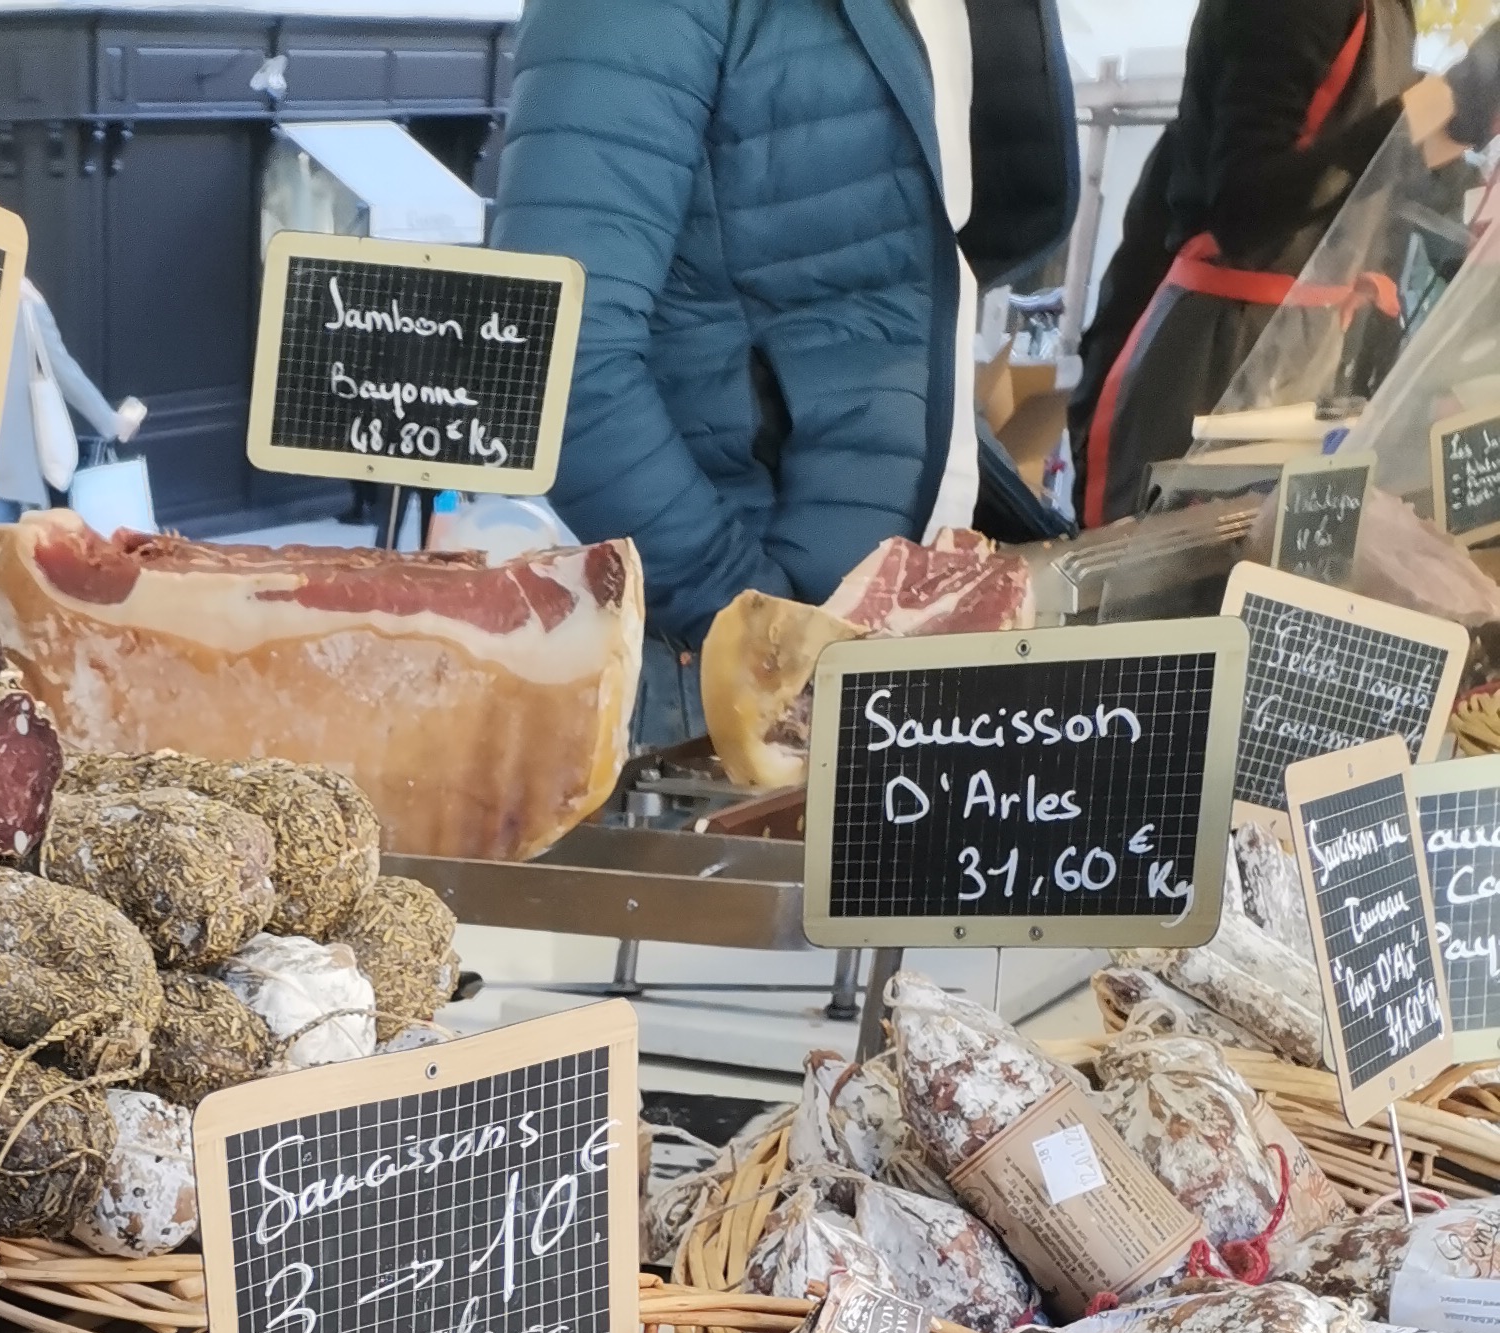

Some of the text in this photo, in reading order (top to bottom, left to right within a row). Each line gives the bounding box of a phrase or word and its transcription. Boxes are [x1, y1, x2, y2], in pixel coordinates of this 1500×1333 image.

[324, 275, 529, 343] Jambon de
[330, 360, 479, 420] Bayonne
[864, 688, 1142, 752] Saucisson
[884, 769, 1083, 825] D'Arles
[1308, 819, 1408, 887] Saucisson au
[255, 1109, 541, 1246] Saucissons
